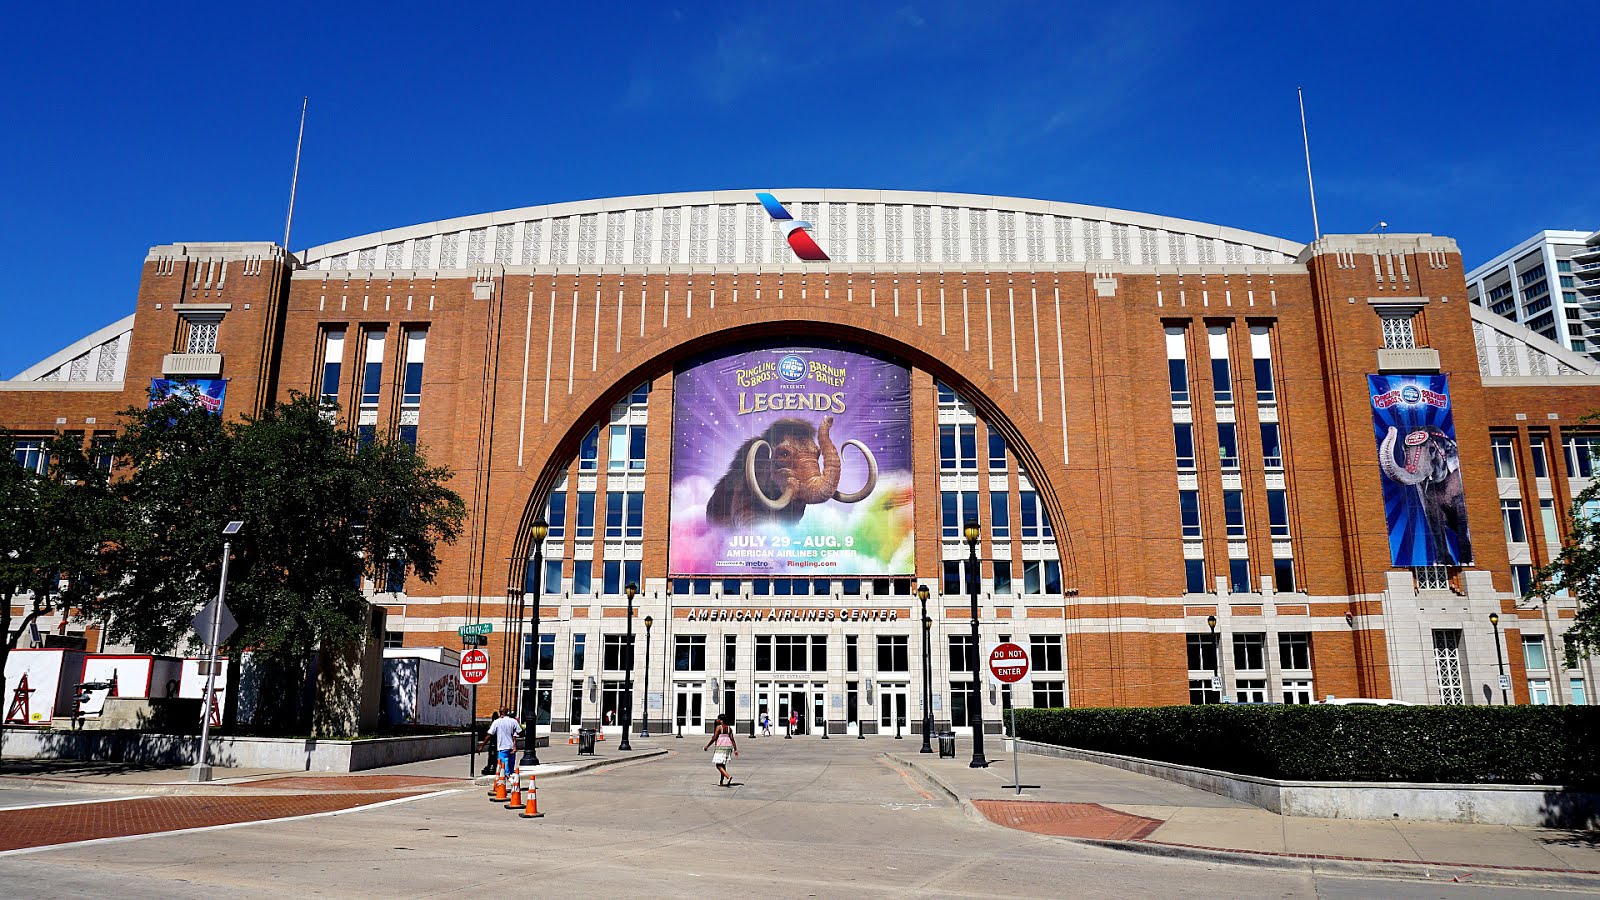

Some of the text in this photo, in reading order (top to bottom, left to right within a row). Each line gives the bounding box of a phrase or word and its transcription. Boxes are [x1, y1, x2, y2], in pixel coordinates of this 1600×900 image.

[736, 362, 776, 387] RINGLING
[809, 361, 846, 378] BARNUM
[815, 371, 845, 387] BAILEY
[738, 391, 847, 416] LEGENDS
[729, 535, 766, 548] JULY
[771, 535, 791, 548] 29
[803, 535, 841, 548] AUG.
[844, 535, 854, 548] 9
[726, 549, 857, 557] AMERICAN AIRLINES CENTER
[787, 560, 837, 568] Ringling.com
[688, 608, 898, 621] AMERICAN AIRLINES CENTER
[460, 624, 481, 635] Victory
[1008, 650, 1023, 658] NOT
[998, 668, 1022, 676] ENTER
